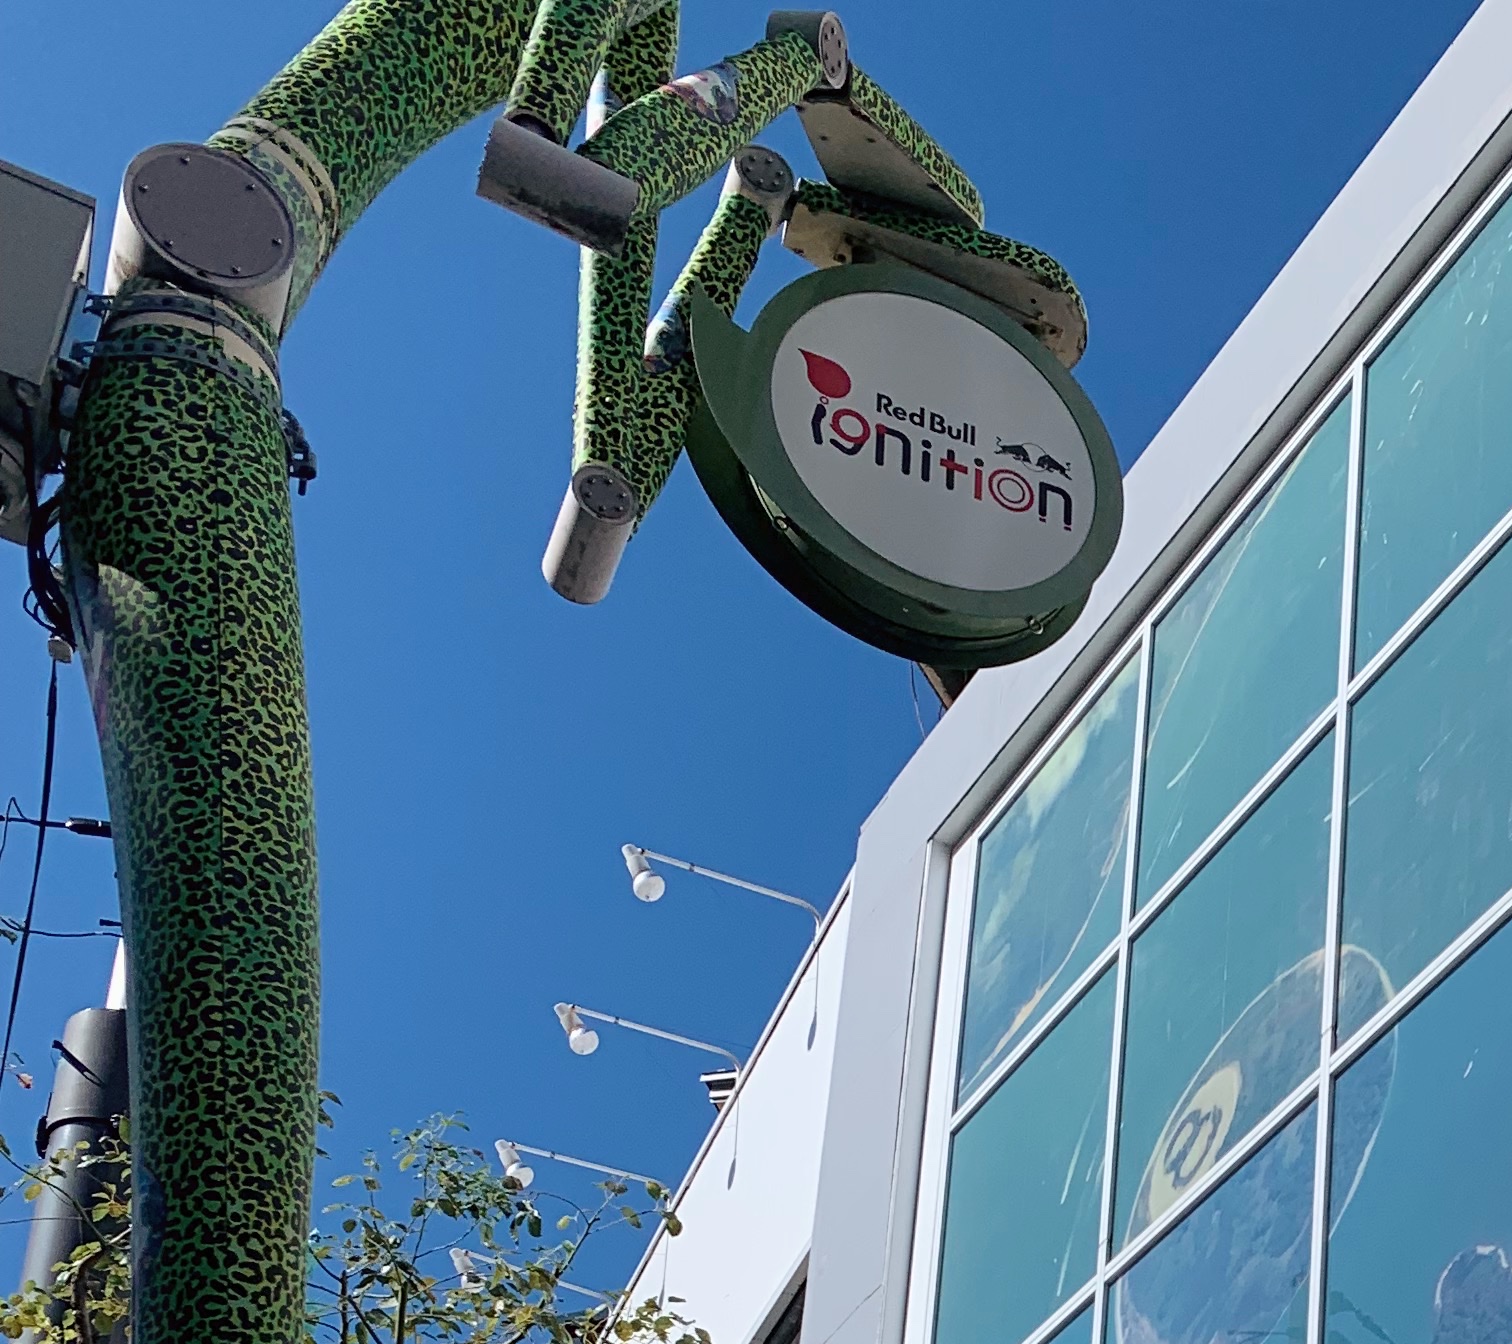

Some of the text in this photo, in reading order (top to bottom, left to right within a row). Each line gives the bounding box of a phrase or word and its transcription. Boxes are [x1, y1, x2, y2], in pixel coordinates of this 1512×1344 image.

[811, 395, 1073, 532] ignition
[876, 393, 976, 447] Red Bull
